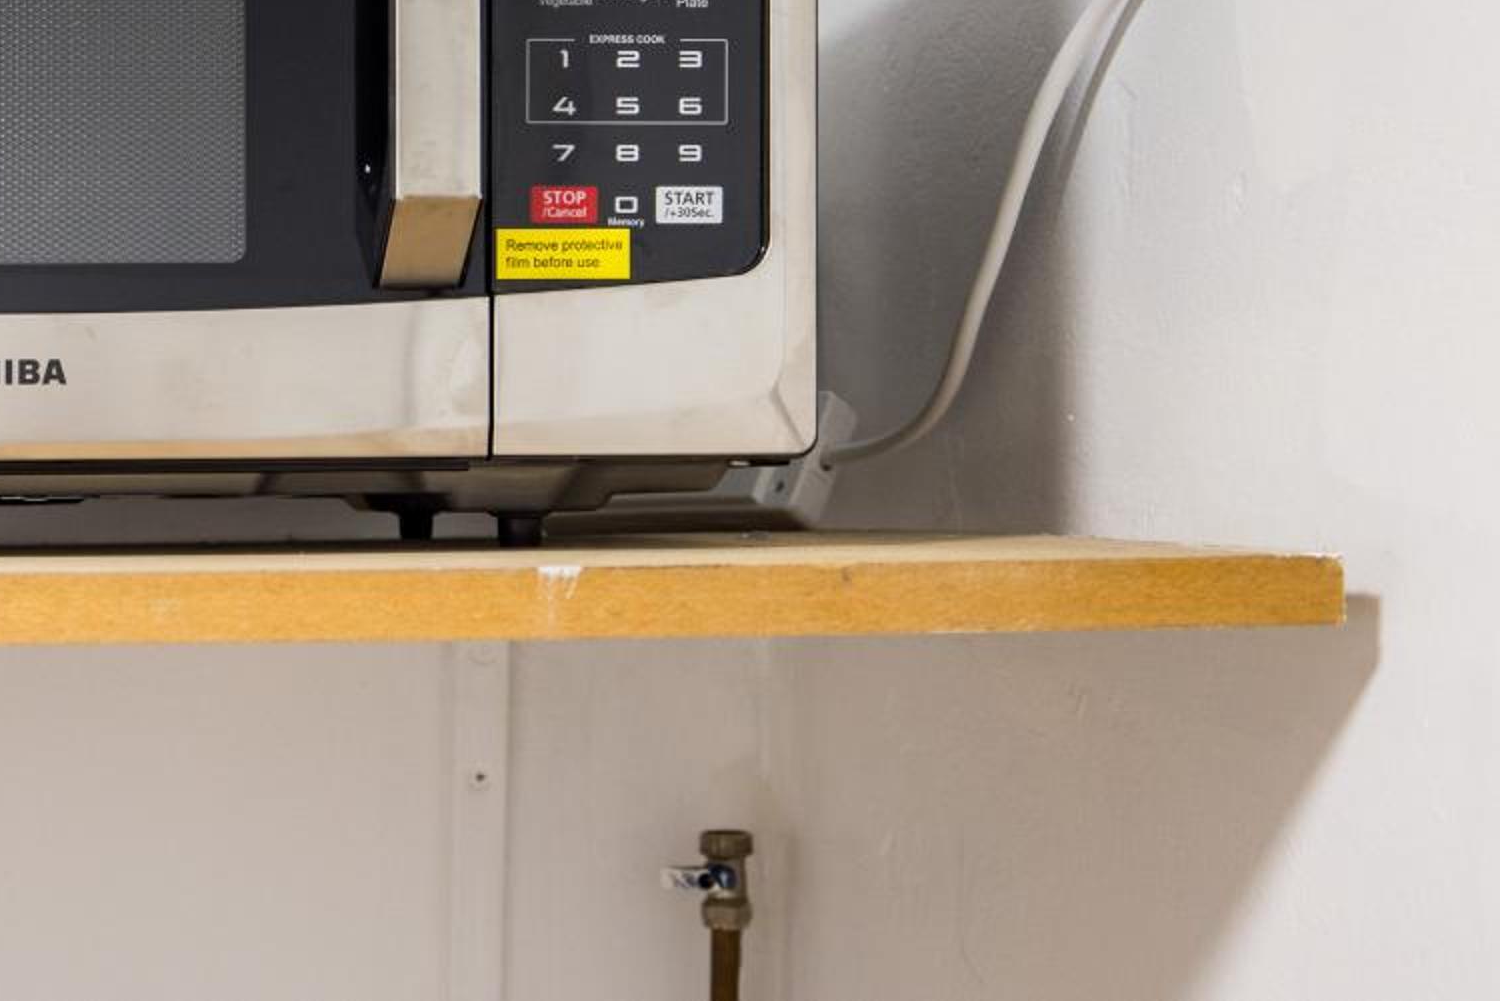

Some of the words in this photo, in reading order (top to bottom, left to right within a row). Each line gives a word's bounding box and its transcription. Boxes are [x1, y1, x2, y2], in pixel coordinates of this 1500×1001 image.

[589, 34, 634, 44] EXPRESS
[636, 34, 665, 44] COOK
[559, 49, 569, 69] 1
[616, 50, 640, 68] 2
[678, 50, 703, 68] 3
[552, 96, 577, 116] 4
[616, 97, 640, 115] 5
[678, 97, 703, 115] 6
[552, 144, 576, 162] 7
[616, 144, 640, 162] 8
[678, 144, 703, 162] 9
[543, 190, 587, 204] STOP
[665, 191, 715, 205] START
[542, 206, 587, 219] /Cancel
[665, 206, 715, 219] /+30Sec.
[607, 217, 645, 228] Memory
[505, 238, 558, 251] Remove
[561, 238, 623, 254] protective
[505, 257, 530, 268] film
[533, 257, 573, 269] before
[577, 259, 600, 269] use
